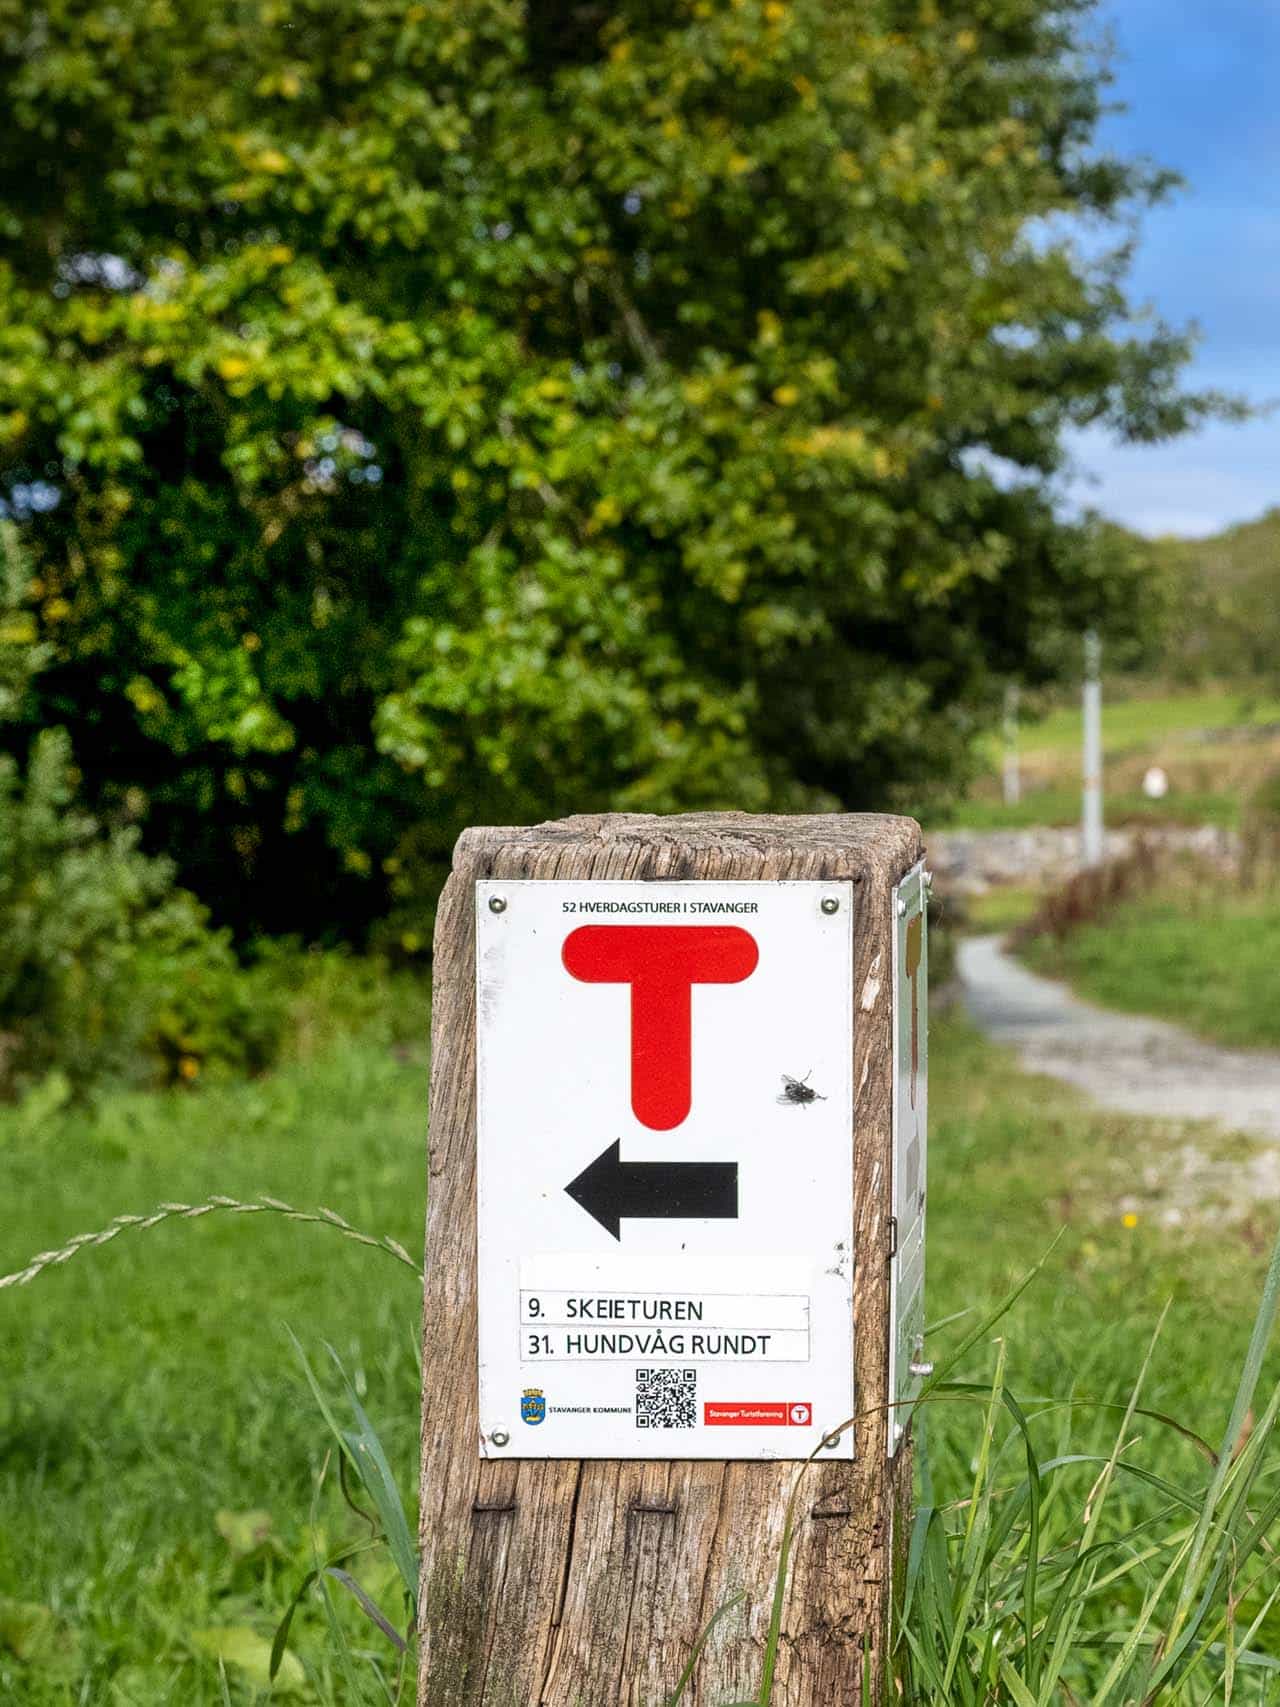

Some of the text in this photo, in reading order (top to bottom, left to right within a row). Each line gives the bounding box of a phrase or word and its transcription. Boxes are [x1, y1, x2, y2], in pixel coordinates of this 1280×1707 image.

[562, 902, 577, 913] 52
[579, 902, 681, 913] HVERDAGSTURER
[689, 902, 759, 914] STAVANGER
[561, 925, 759, 1131] T
[528, 1298, 703, 1321] 9. SKEIETUREN
[528, 1329, 772, 1355] 31. HUNDVÅG RUNDT
[709, 1409, 740, 1419] Stavanger
